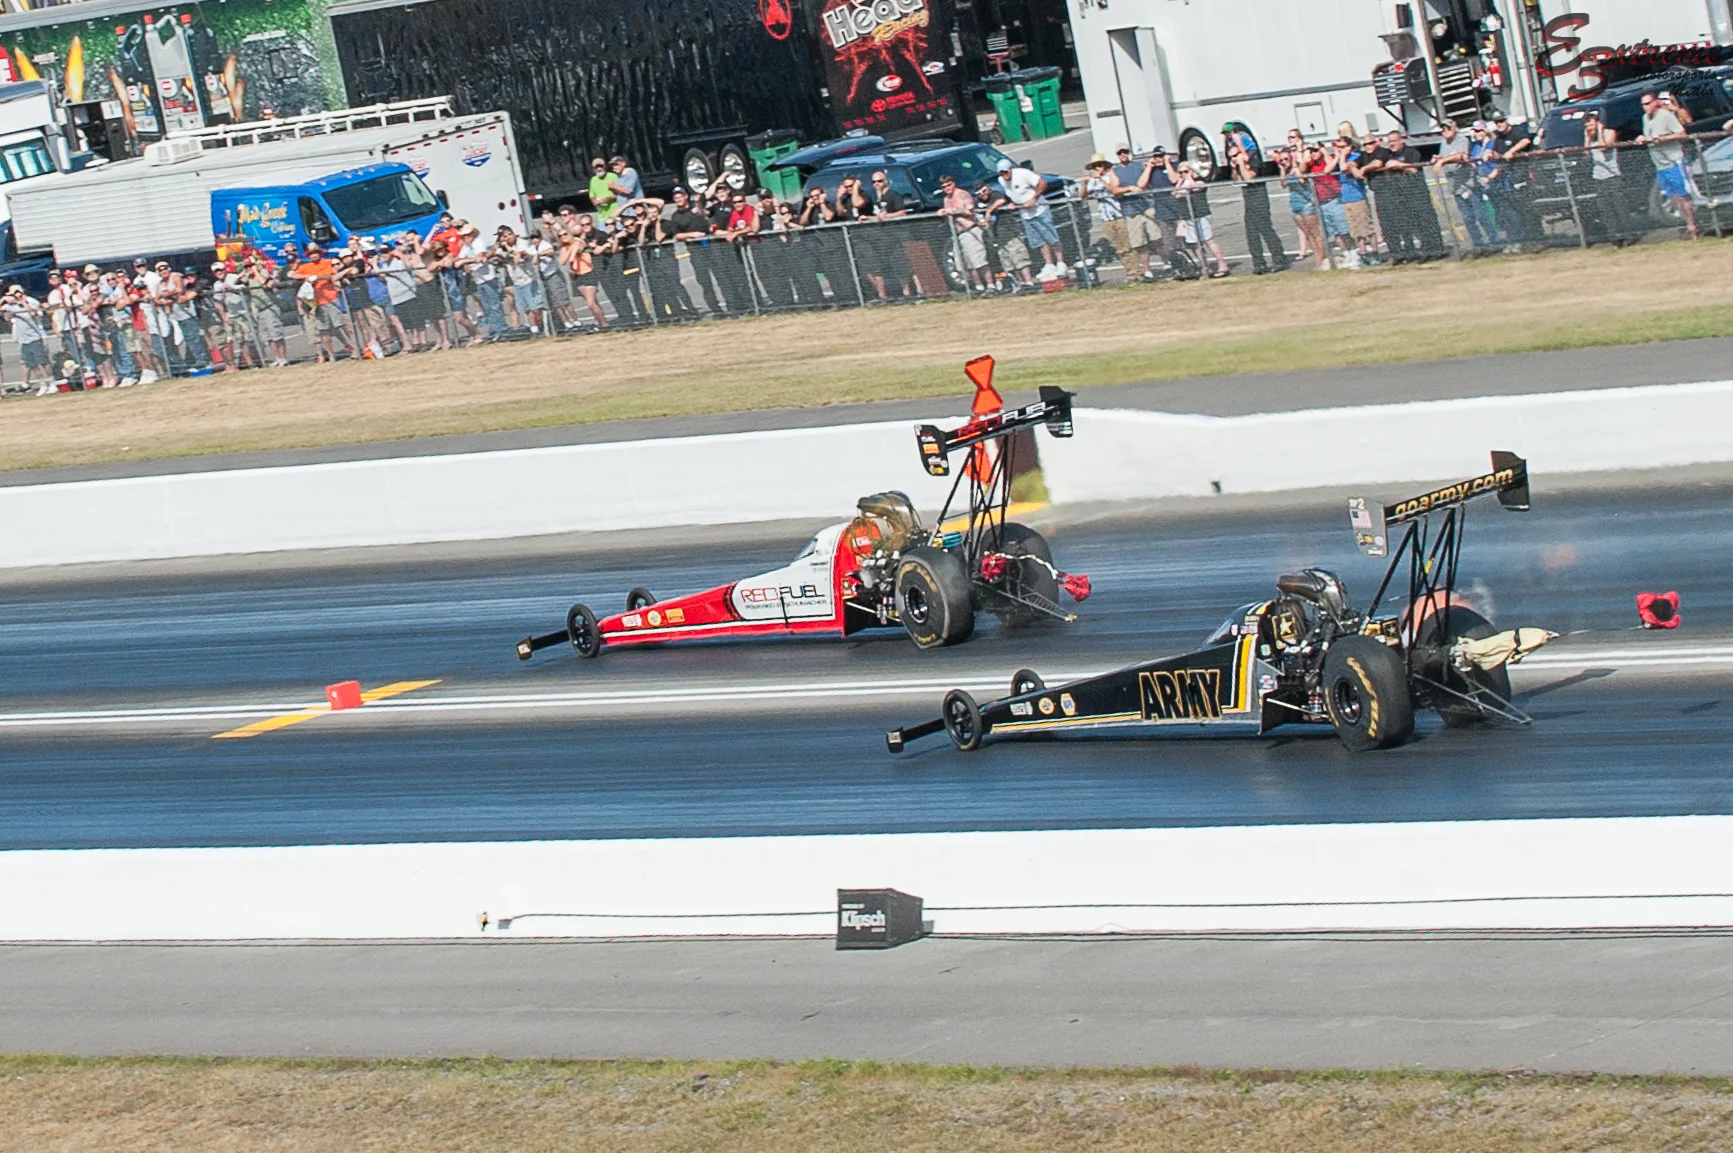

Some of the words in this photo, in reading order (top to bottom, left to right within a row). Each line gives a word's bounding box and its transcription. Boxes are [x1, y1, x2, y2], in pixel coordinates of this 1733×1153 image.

[1395, 468, 1513, 520] goarmy.com
[1138, 668, 1221, 720] ARMY
[841, 909, 886, 931] Klipsch
